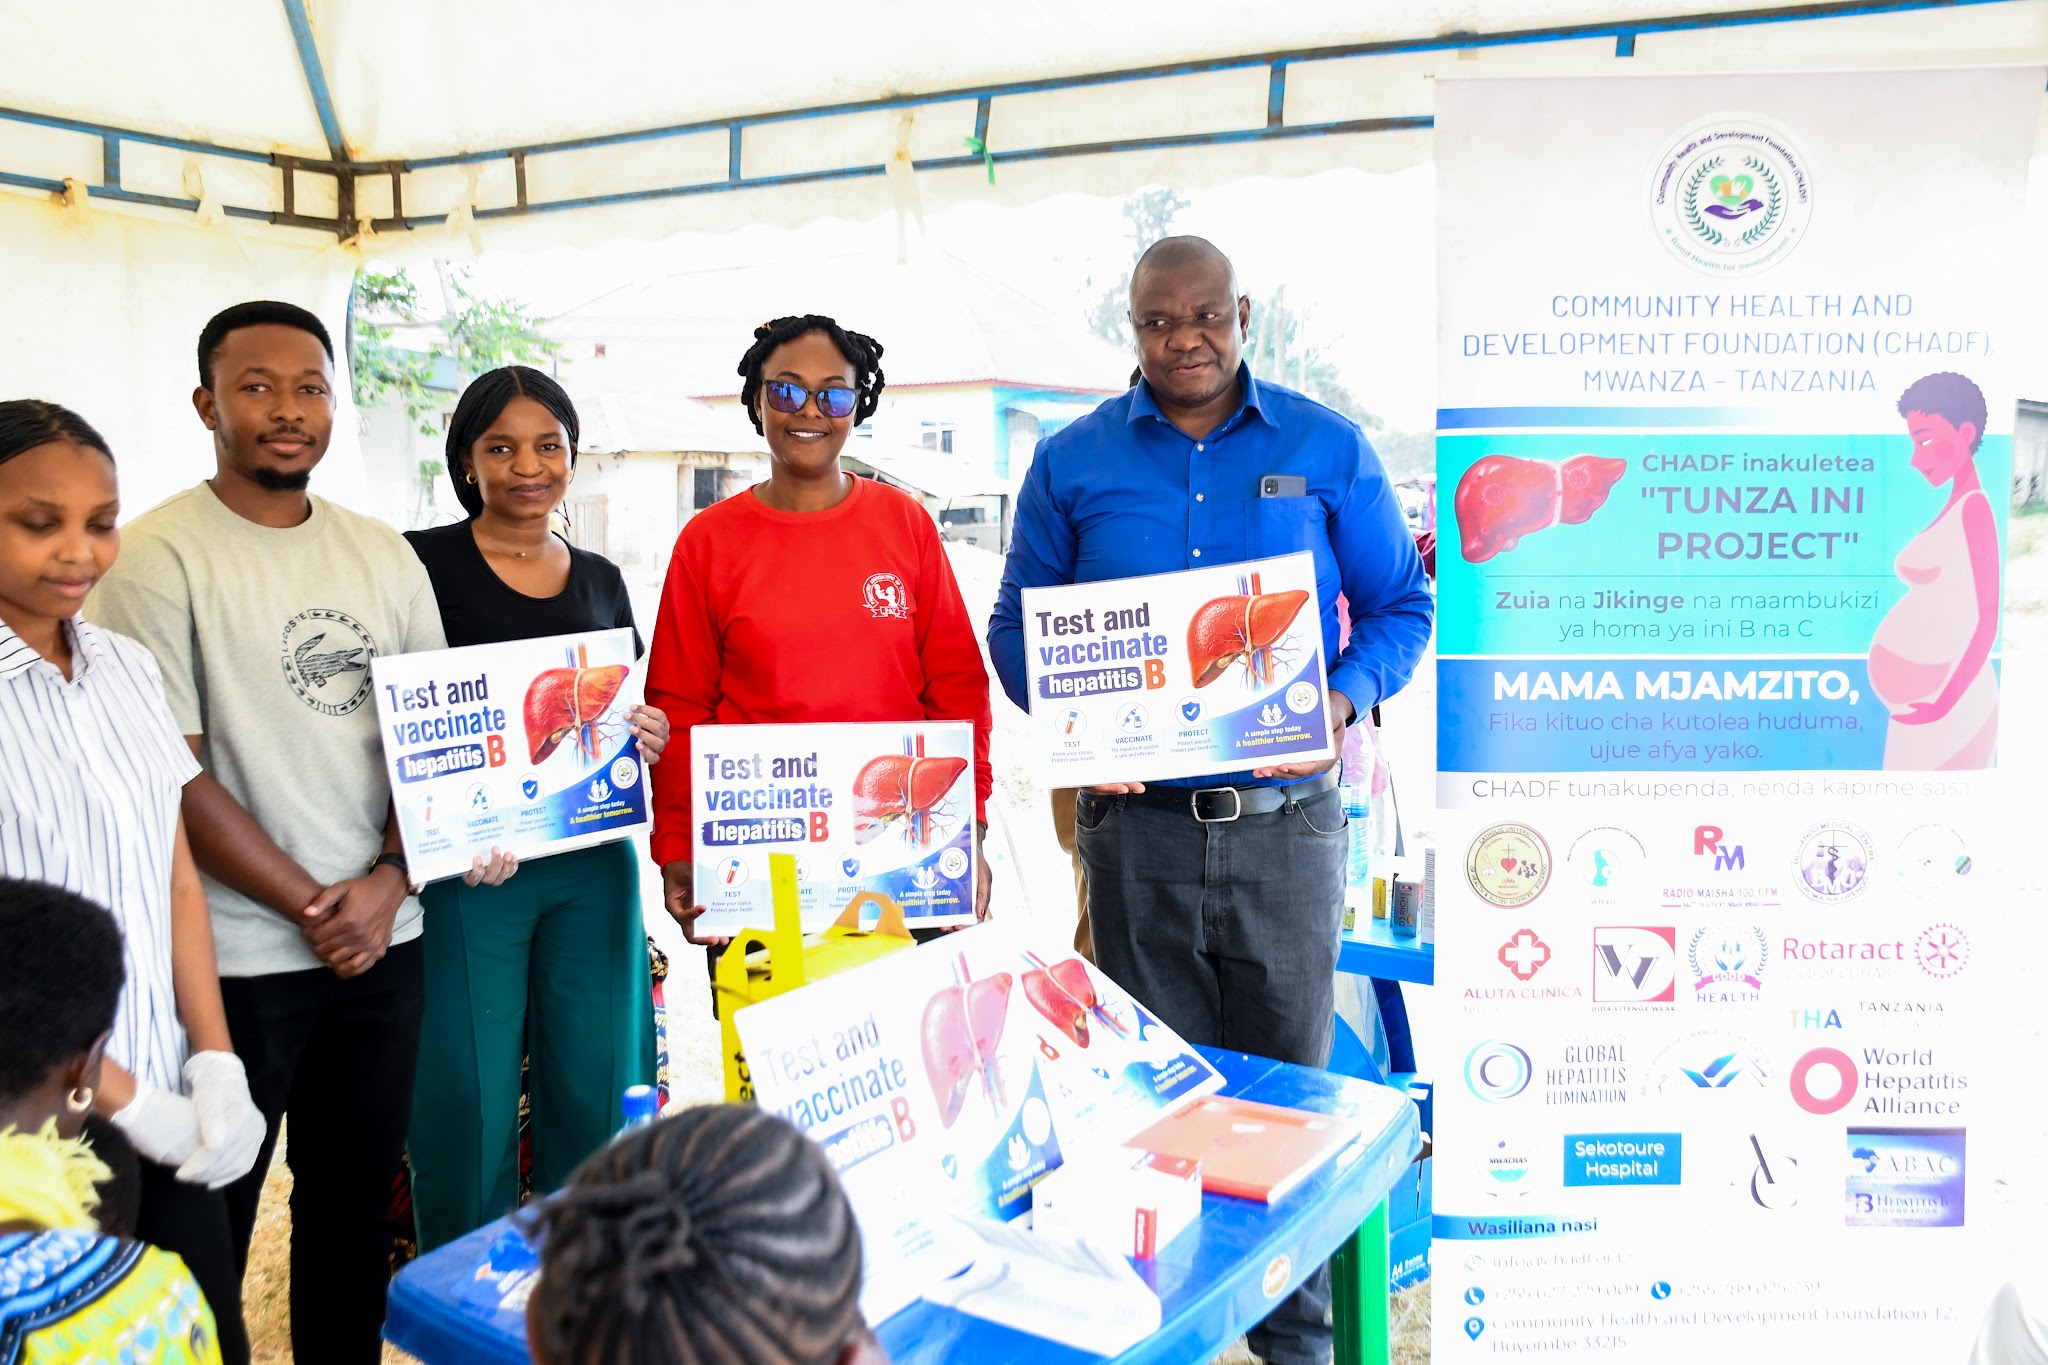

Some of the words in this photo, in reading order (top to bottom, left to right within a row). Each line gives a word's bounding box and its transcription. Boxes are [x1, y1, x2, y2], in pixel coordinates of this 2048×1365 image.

[1552, 295, 1720, 318] COMMUNITY
[1731, 294, 1842, 317] HEALTH
[1852, 294, 1913, 317] AND
[1463, 333, 1673, 357] DEVELOPMENT
[1685, 332, 1865, 355] FOUNDATION
[1583, 370, 1706, 392] MWANZA
[1733, 369, 1877, 392] TANZANIA
[1642, 454, 1735, 473] CHADF
[1742, 453, 1875, 473] inakuletea
[1641, 486, 1798, 515] "TUNZA
[1811, 486, 1865, 514] INI
[1657, 531, 1859, 560] PROJECT"
[1495, 591, 1550, 610] Zuia
[1558, 596, 1586, 610] na
[1592, 590, 1685, 615] Jikinge
[1693, 595, 1721, 609] na
[1731, 590, 1879, 609] maambukizi
[1036, 608, 1095, 637] Test
[1103, 602, 1150, 631] and
[1559, 624, 1585, 643] ya
[1592, 620, 1661, 638] homa
[1667, 623, 1695, 642] ya
[1700, 619, 1732, 638] ini
[1739, 620, 1756, 638] B
[1763, 624, 1792, 638] na
[1797, 620, 1814, 638] C
[281, 612, 308, 653] LACOSTE
[1039, 631, 1168, 666] vaccinate
[1049, 667, 1139, 697] hepatitis
[1144, 658, 1167, 691] B
[1494, 671, 1624, 701] MAMA
[1636, 669, 1859, 705] MJAMZITO,
[386, 680, 438, 713] Test
[447, 674, 489, 705] and
[393, 705, 506, 746] vaccinate
[1178, 728, 1209, 738] PROTECT
[1250, 729, 1270, 737] simple
[1285, 725, 1302, 733] today
[1489, 713, 1538, 732] Fika
[1546, 711, 1604, 732] kituo
[1611, 711, 1655, 731] cha
[1663, 711, 1750, 731] kutolea
[1758, 711, 1864, 734] huduma,
[1115, 734, 1153, 744] VACCINATE
[1235, 740, 1241, 748] A
[1242, 737, 1275, 747] healthier
[1275, 732, 1313, 743] tomorrow.
[404, 745, 485, 779] hepatitis
[487, 735, 507, 768] B
[1589, 741, 1641, 763] ujue
[1648, 740, 1697, 763] afya
[1703, 740, 1763, 763] yako.
[703, 752, 763, 780] Test
[772, 752, 818, 779] and
[705, 783, 833, 812] vaccinate
[1472, 779, 1561, 799] CHADF
[1568, 779, 1734, 802] tunakupenda,
[1743, 778, 1815, 797] nenda
[1823, 777, 1914, 800] kapime
[520, 806, 547, 817] PROTECT
[576, 812, 602, 823] healthier
[604, 807, 635, 818] tomorrow.
[582, 805, 599, 813] simple
[425, 828, 440, 837] TEST
[467, 815, 499, 828] VACCINATE
[712, 819, 803, 844] hepatitis
[809, 811, 829, 843] B
[1820, 821, 1855, 833] MEDICAL
[1855, 830, 1875, 861] CENTRE
[905, 891, 923, 899] simple
[924, 890, 935, 898] step
[936, 888, 951, 896] today
[928, 897, 960, 905] tomorrow.
[1662, 888, 1694, 898] RADIO
[1697, 888, 1735, 898] MAISHA
[1738, 888, 1761, 898] 100.1
[1765, 887, 1778, 897] FM
[1783, 937, 1905, 961] Rotaract
[1712, 972, 1746, 982] GOOD
[1463, 988, 1516, 1000] ALUTA
[1520, 987, 1583, 999] CLINICA
[1696, 992, 1759, 1003] HEALTH
[1789, 1008, 1842, 1029] THA
[1859, 1001, 1944, 1013] TANZANIA
[761, 1033, 827, 1088] Test
[833, 1011, 881, 1062] and
[1565, 1044, 1626, 1063] GLOBAL
[1863, 1047, 1933, 1067] World
[1546, 1066, 1627, 1086] HEPATITIS
[1864, 1071, 1968, 1094] Hepatitis
[1546, 1088, 1627, 1105] ELIMINATION
[1863, 1096, 1962, 1115] Alliance
[890, 1096, 917, 1143] B
[1574, 1140, 1665, 1157] Sekotoure
[1585, 1160, 1659, 1179] Hospital
[1877, 1194, 1938, 1206] HEPATITIS
[1467, 1219, 1556, 1236] Wasiliana
[1562, 1216, 1598, 1232] nasi
[1391, 1260, 1403, 1280] A4
[1492, 1313, 1595, 1333] Community
[1601, 1311, 1659, 1326] Health
[1663, 1311, 1697, 1326] and
[1703, 1308, 1819, 1328] Development
[1826, 1306, 1927, 1322] Foundation
